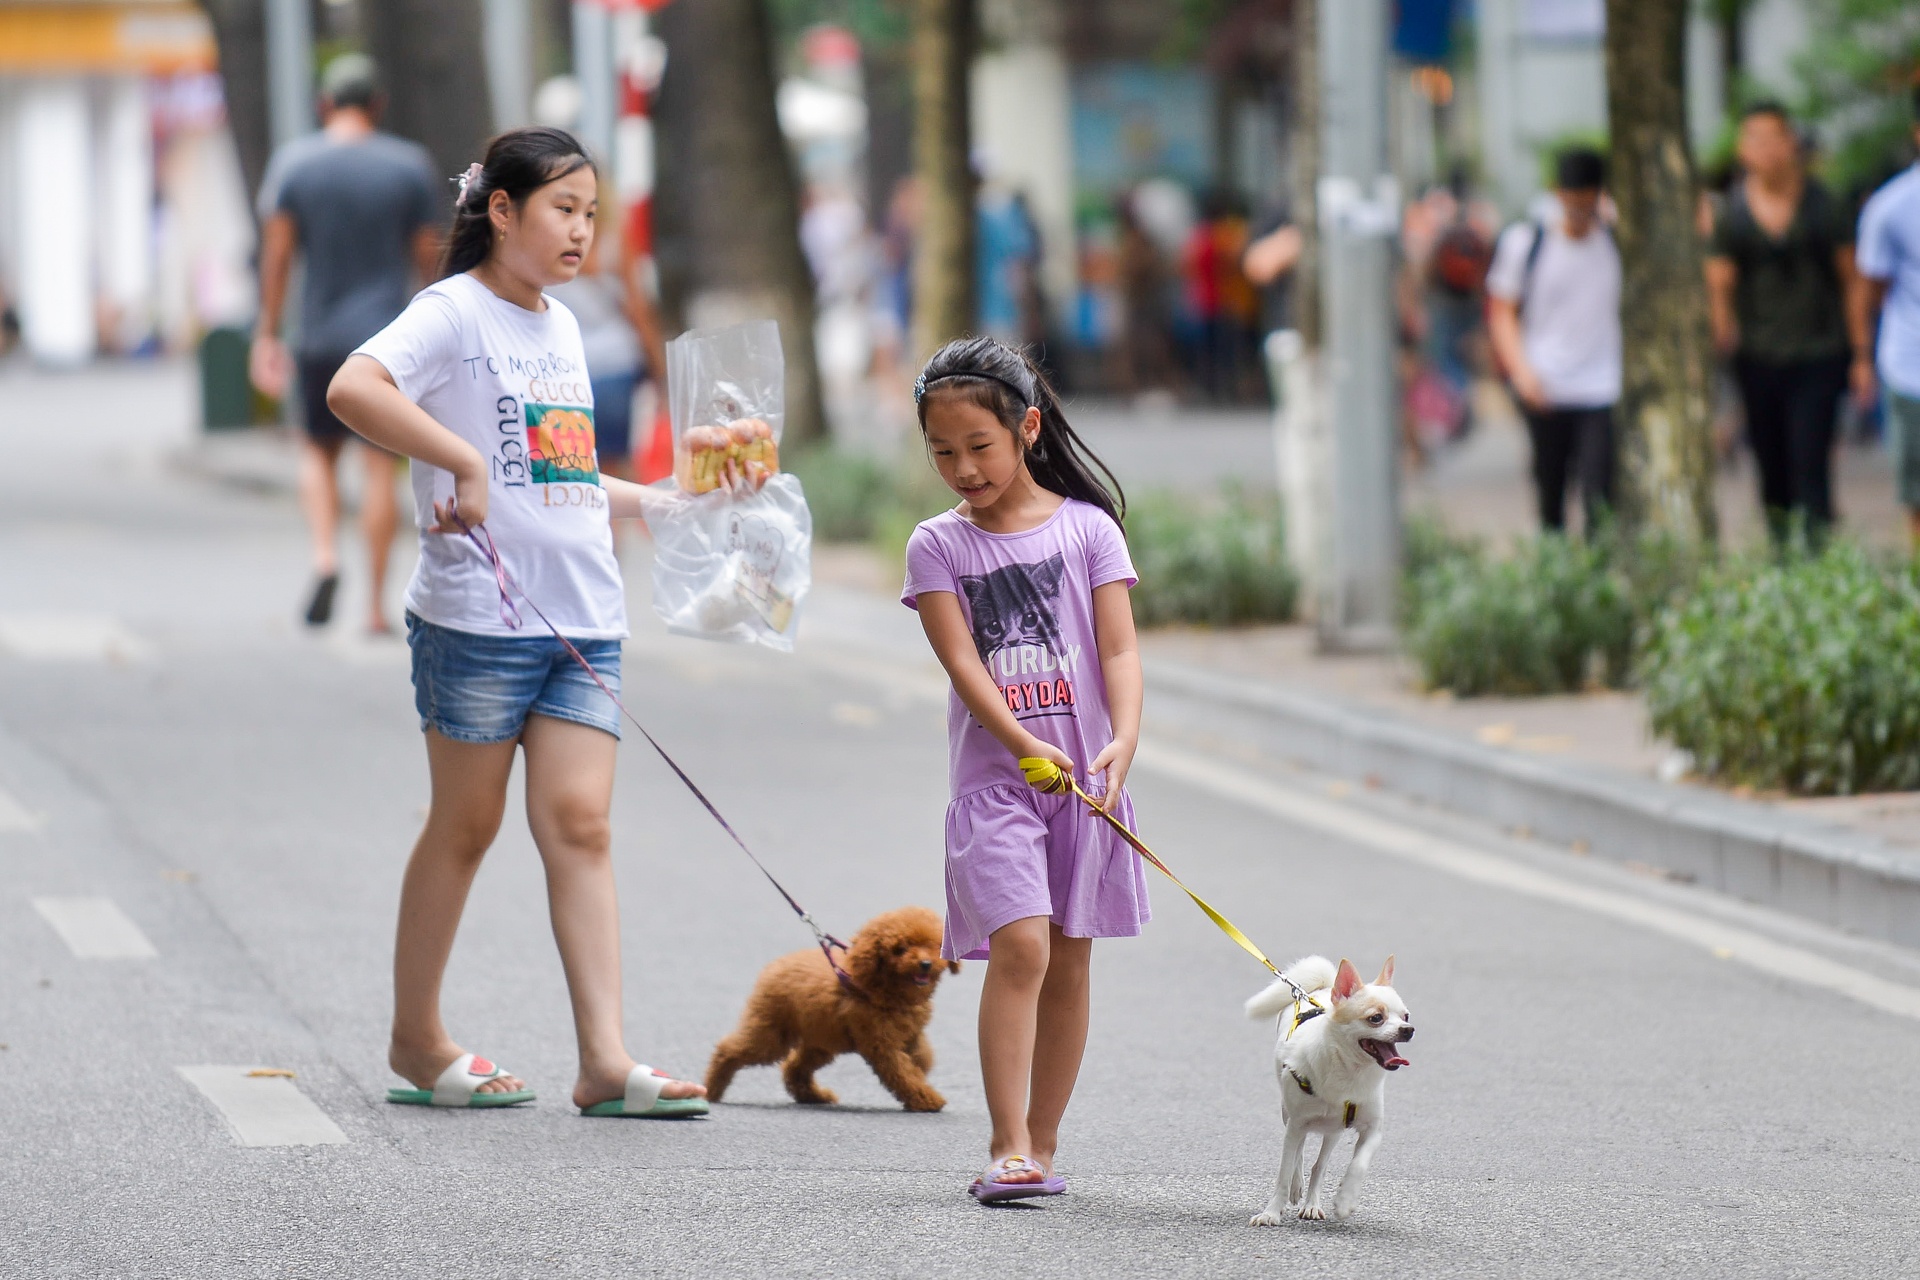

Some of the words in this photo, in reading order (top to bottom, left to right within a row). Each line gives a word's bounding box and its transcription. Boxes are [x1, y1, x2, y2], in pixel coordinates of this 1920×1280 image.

[529, 380, 592, 405] GUCCI
[496, 395, 526, 488] GUCCI
[998, 678, 1076, 713] RYDAY
